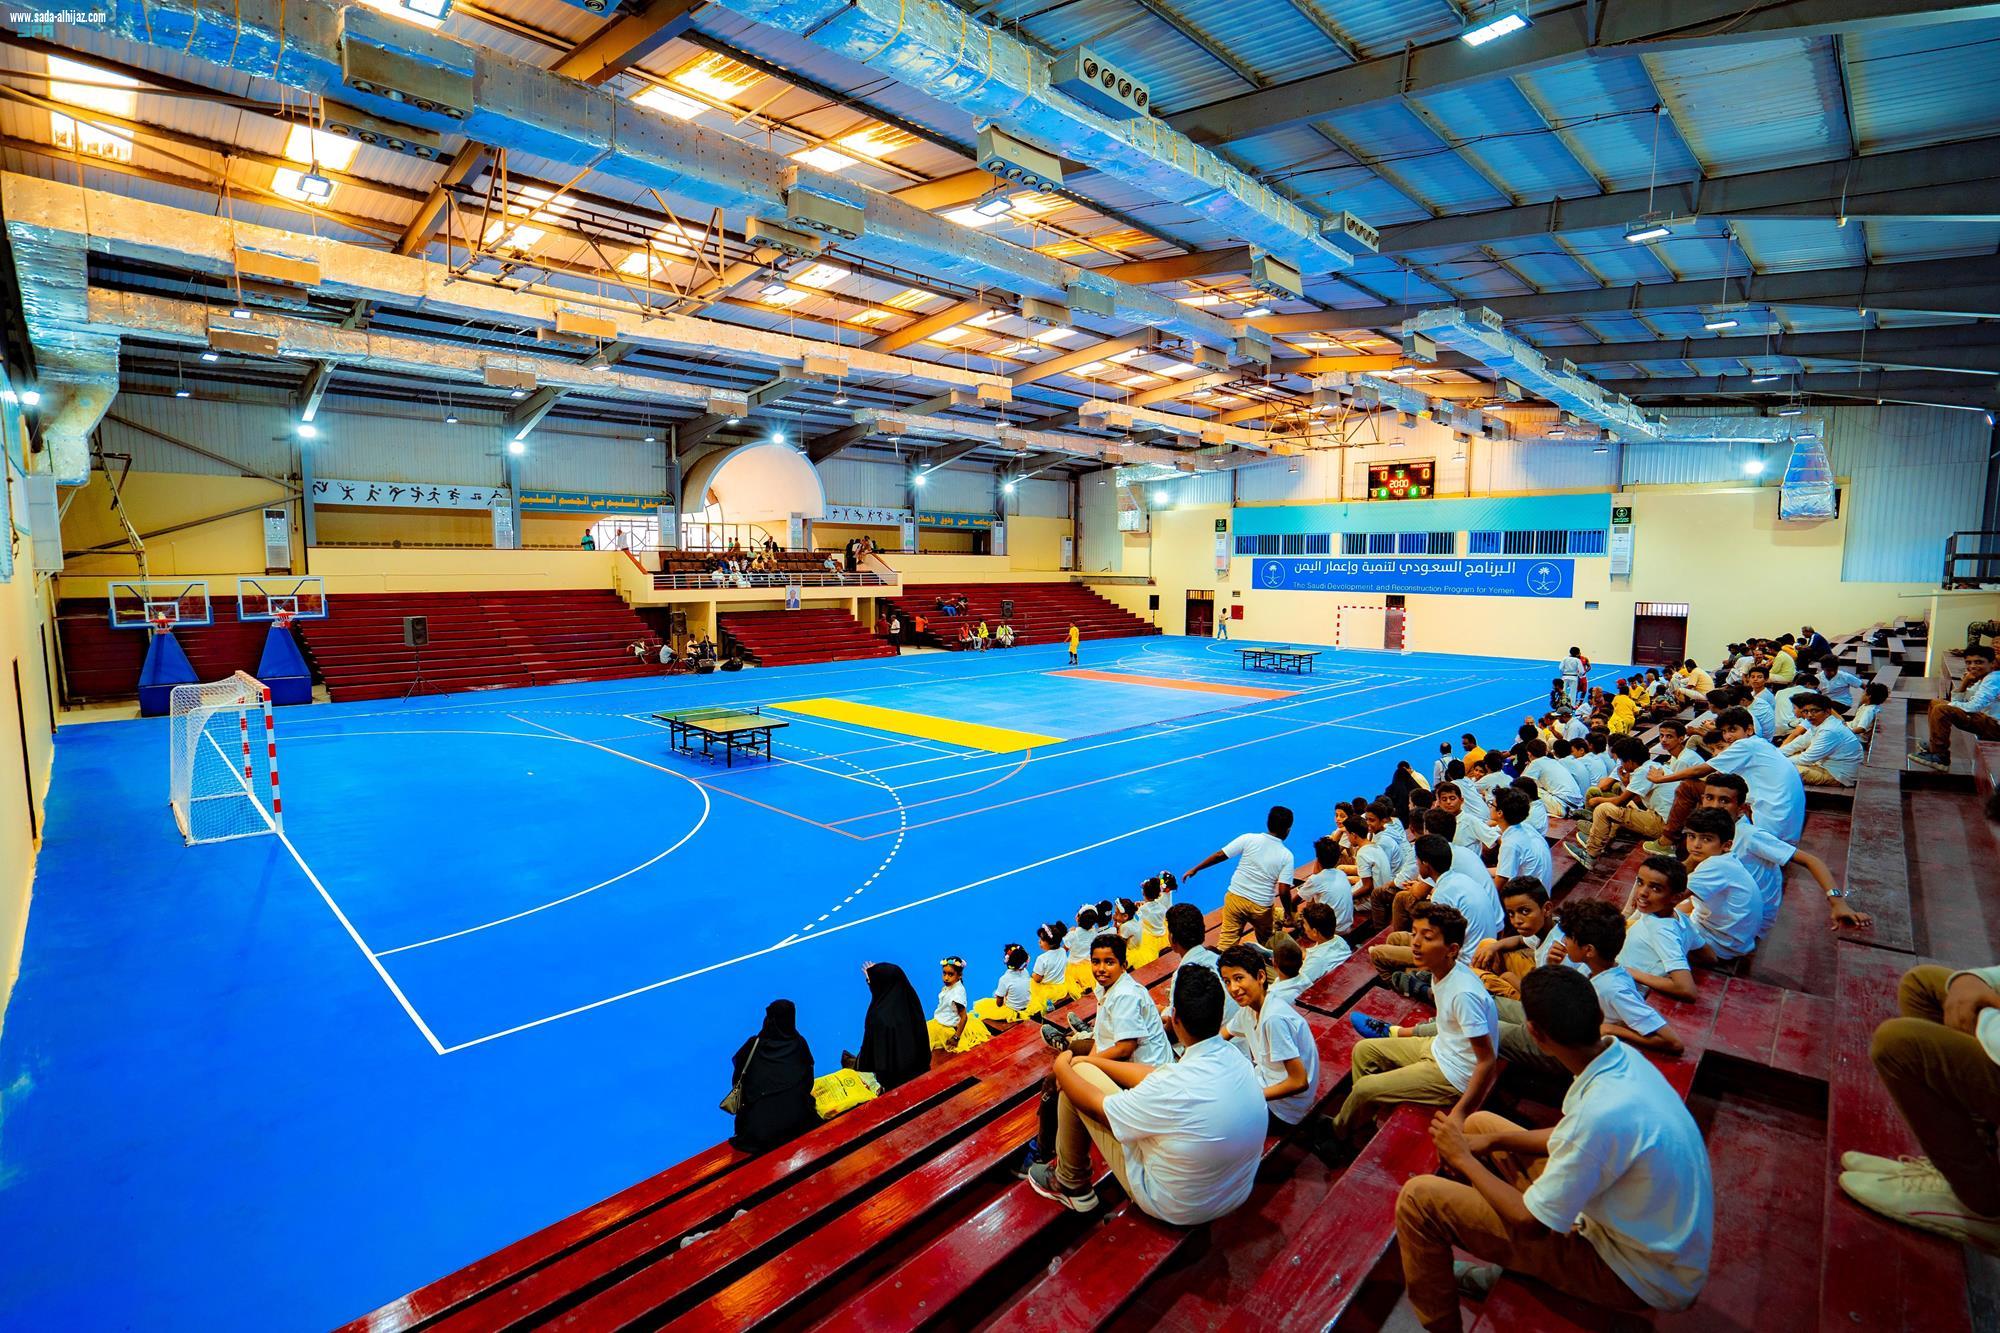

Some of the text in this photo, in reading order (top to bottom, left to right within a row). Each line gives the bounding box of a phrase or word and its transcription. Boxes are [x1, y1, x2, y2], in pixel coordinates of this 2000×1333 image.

[1294, 561, 1516, 577] البرنامج السعودي لتنمية وإعمار اليمن
[1307, 582, 1326, 590] Saudi
[1327, 582, 1373, 592] Development
[1391, 584, 1442, 592] Reconstruction
[1443, 585, 1475, 594] Program
[1488, 586, 1515, 594] Yemen
